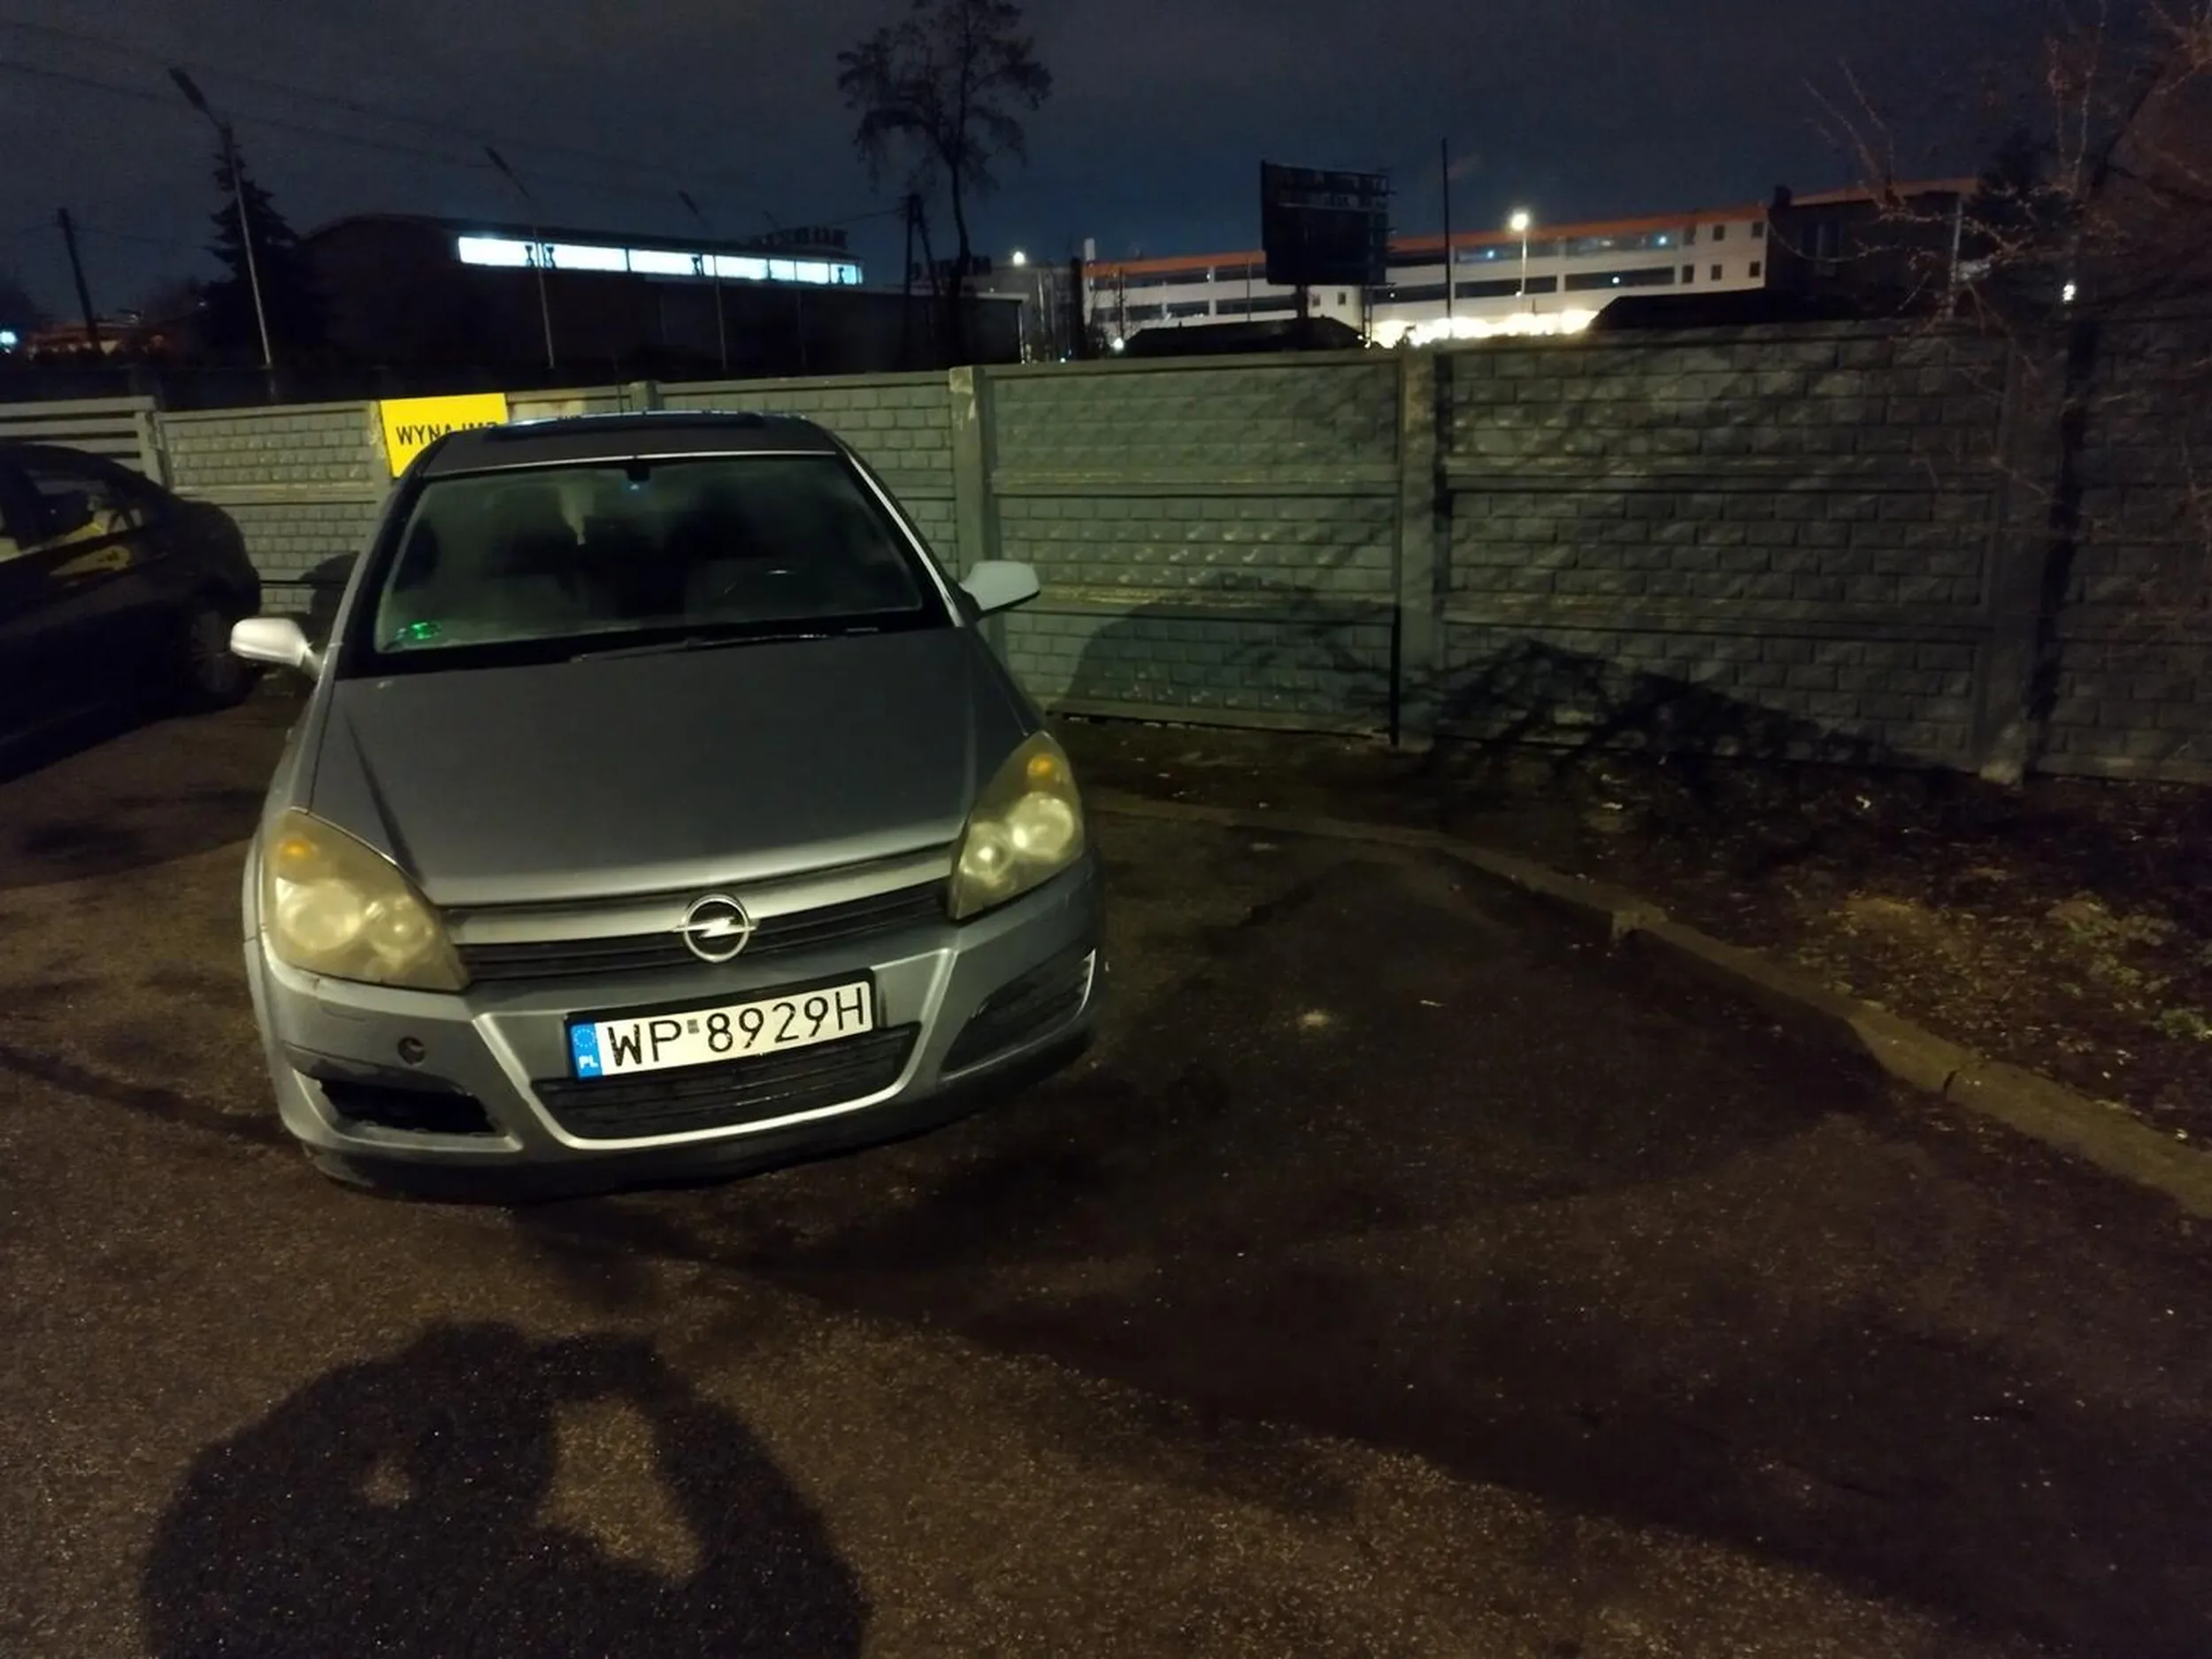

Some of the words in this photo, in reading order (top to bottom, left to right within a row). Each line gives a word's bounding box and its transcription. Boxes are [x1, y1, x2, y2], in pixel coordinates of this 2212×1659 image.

[607, 1019, 682, 1067] WP
[705, 987, 864, 1053] 8929H
[579, 1055, 599, 1069] PL
